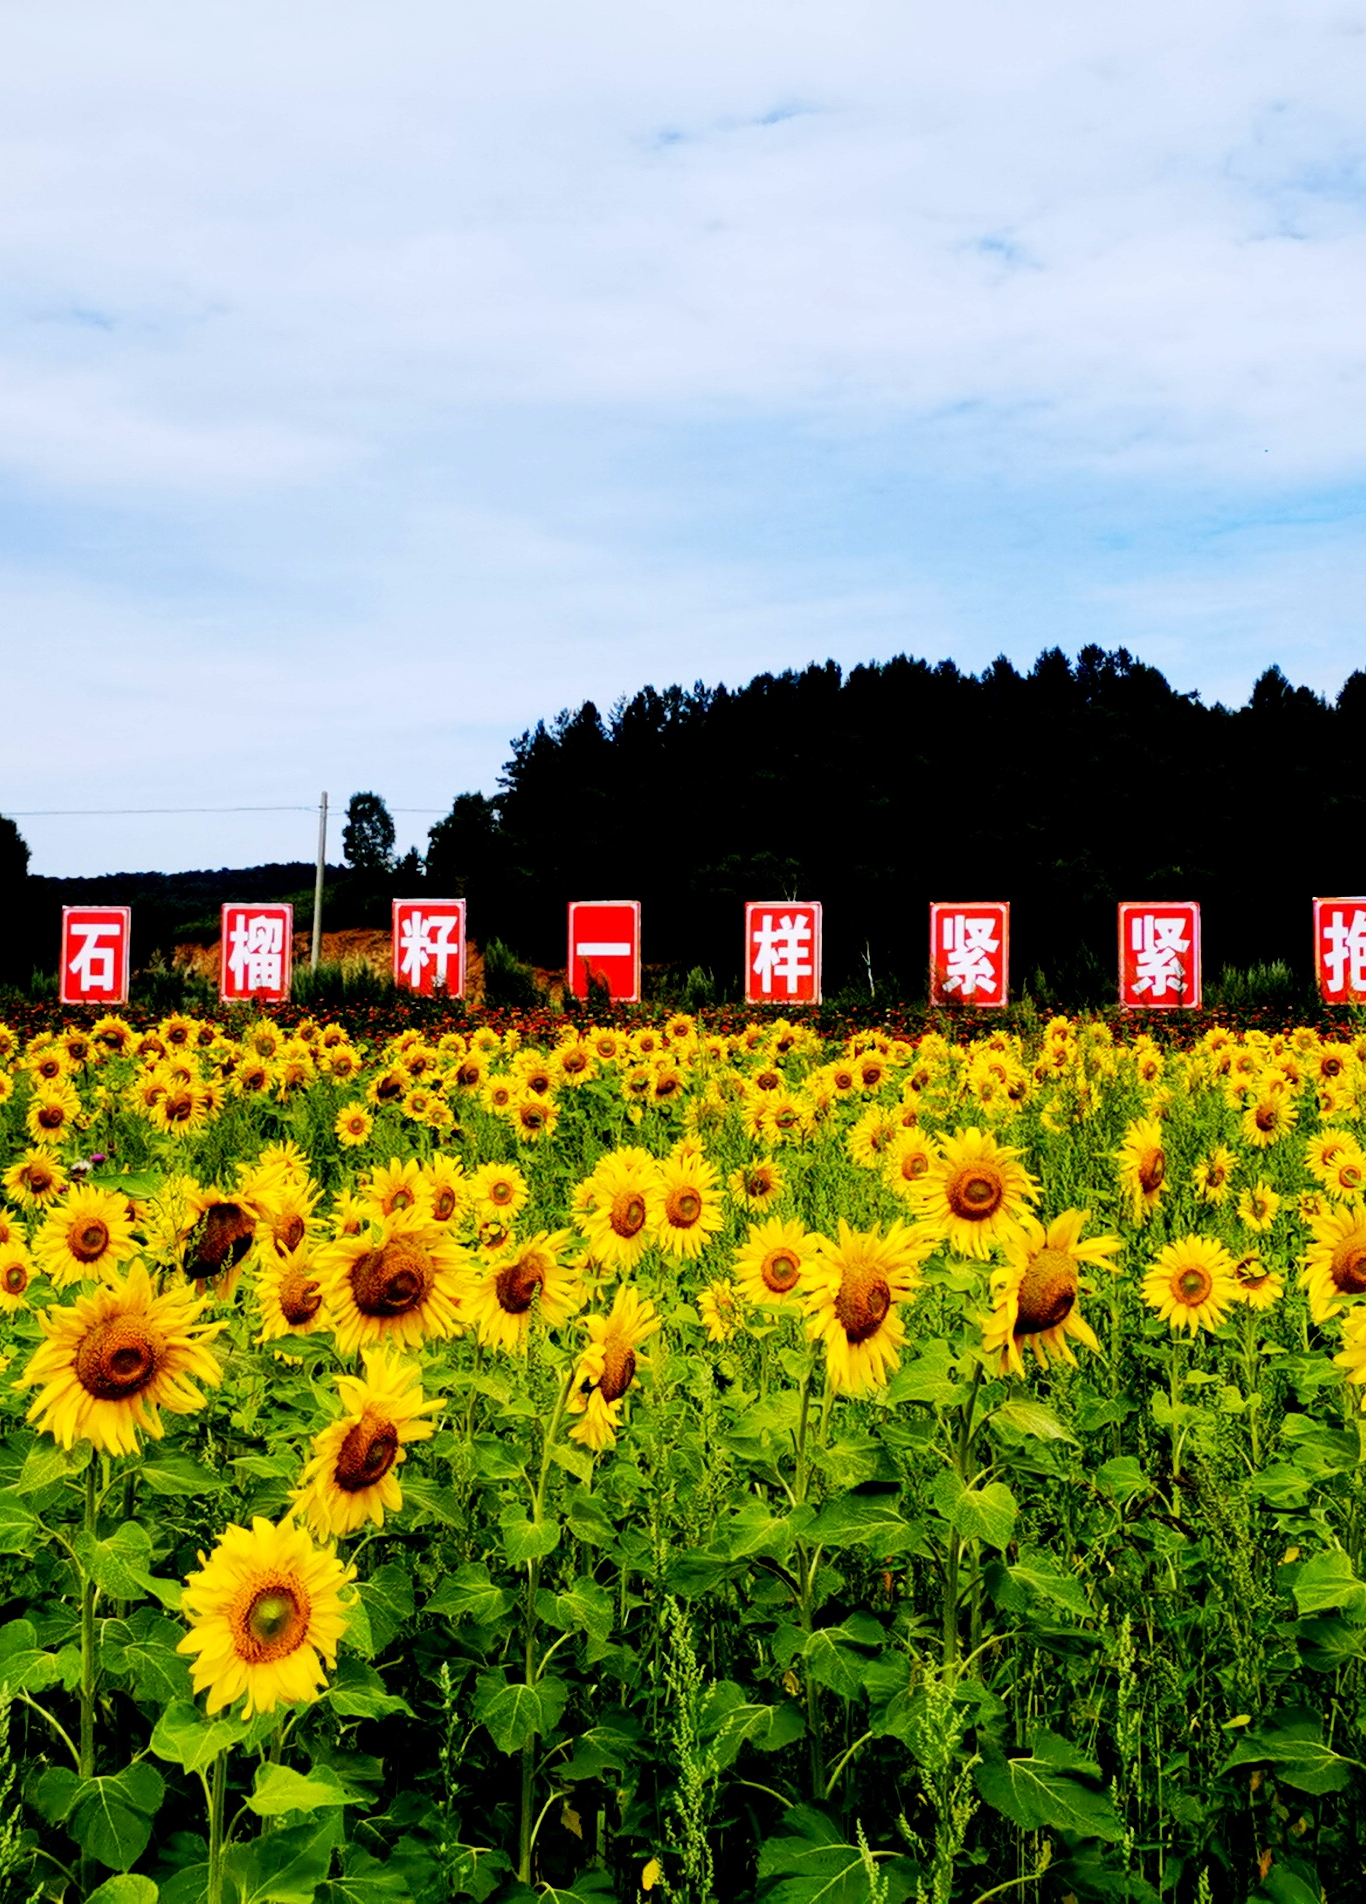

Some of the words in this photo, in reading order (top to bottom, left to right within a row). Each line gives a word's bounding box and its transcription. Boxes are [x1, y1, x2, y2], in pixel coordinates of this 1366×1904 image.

[69, 924, 121, 992] 石
[229, 916, 280, 990] 榴
[401, 912, 457, 987] 籽
[752, 914, 813, 993] 样
[943, 915, 999, 995] 紧
[1129, 915, 1188, 997] 紧
